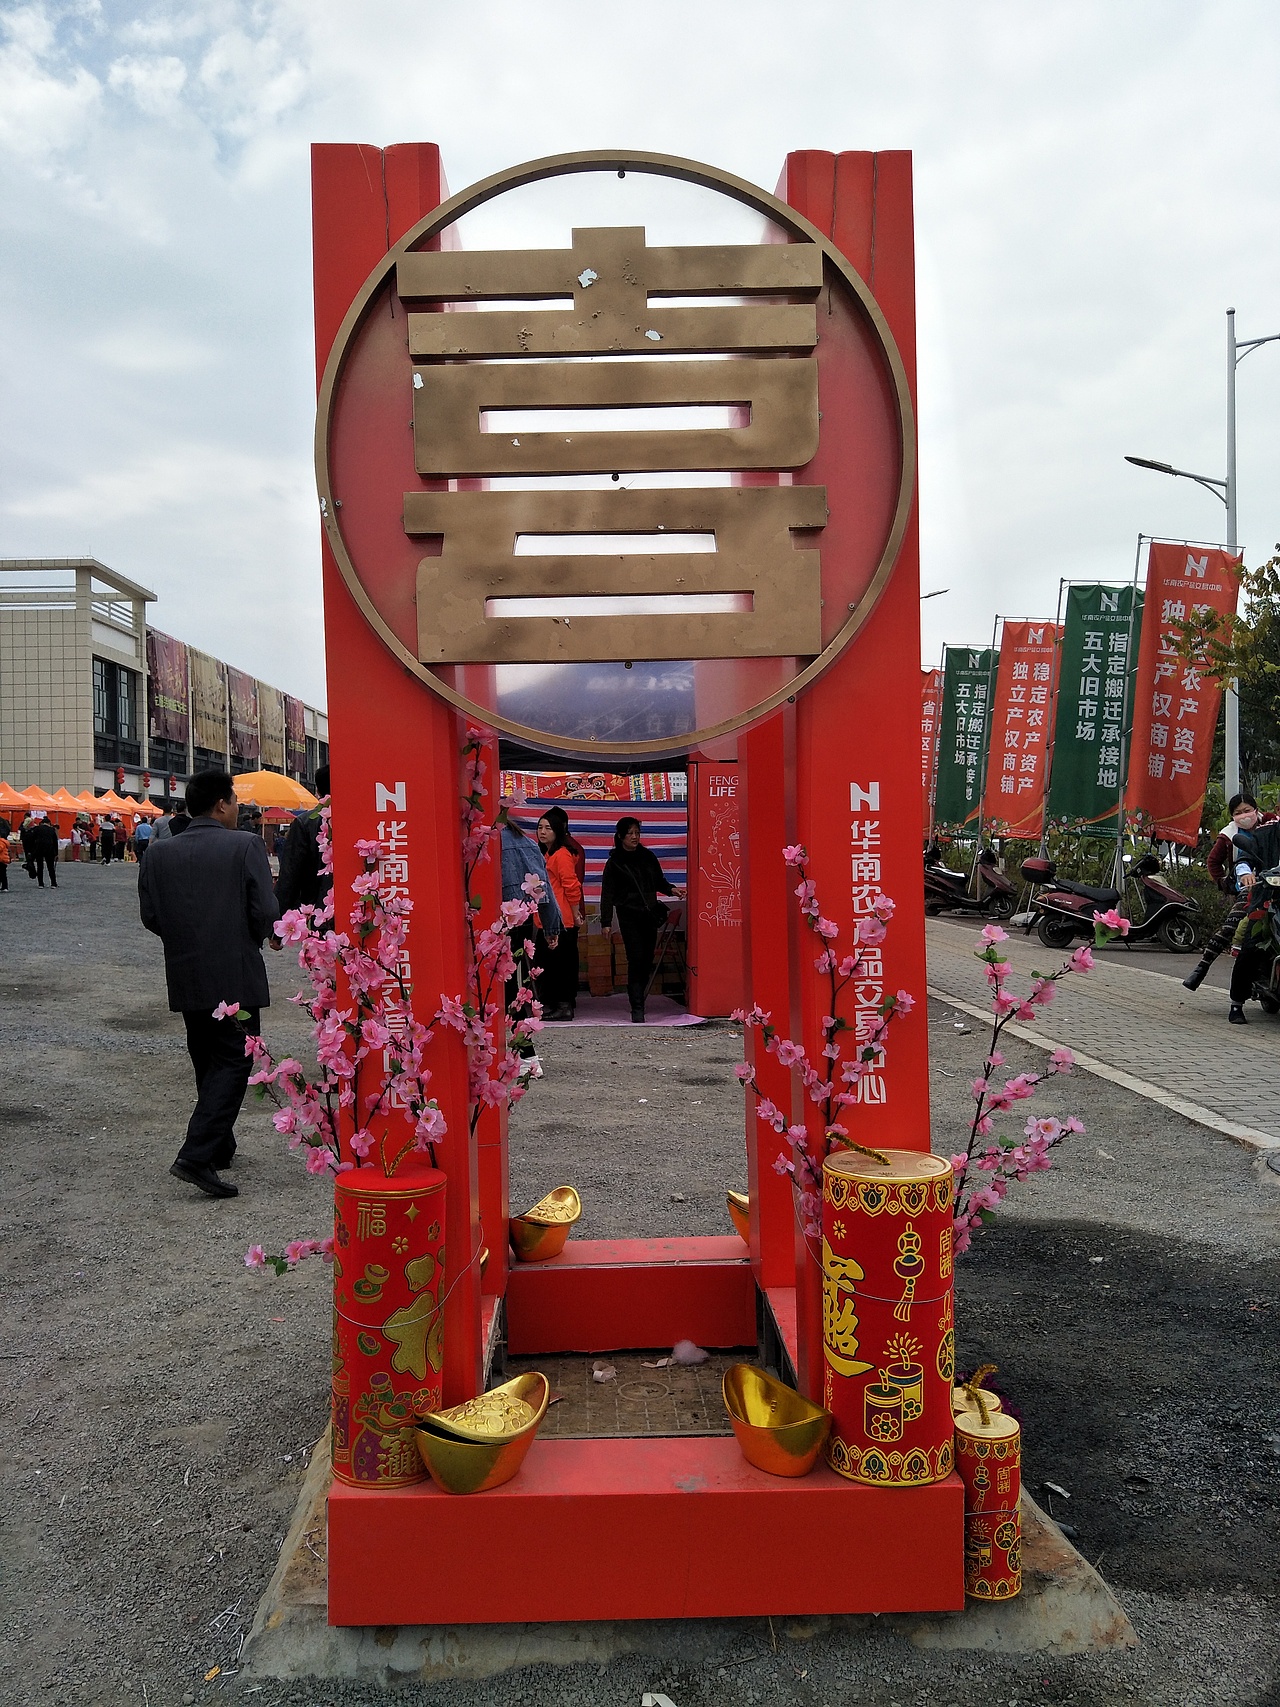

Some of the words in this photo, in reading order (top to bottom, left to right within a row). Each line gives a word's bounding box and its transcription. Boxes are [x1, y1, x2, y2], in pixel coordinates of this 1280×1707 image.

[1000, 662, 1029, 794] 独立产权商铺
[1016, 662, 1050, 795] 稳定农产资产
[1075, 631, 1104, 742] 五大旧市场
[1096, 632, 1129, 789] 指定搬迁承接地
[1147, 599, 1186, 778] 独立产权商铺
[1169, 603, 1211, 782] 农产资产
[709, 776, 739, 785] FENG
[709, 786, 736, 797] LIFE
[356, 1201, 387, 1242] 福
